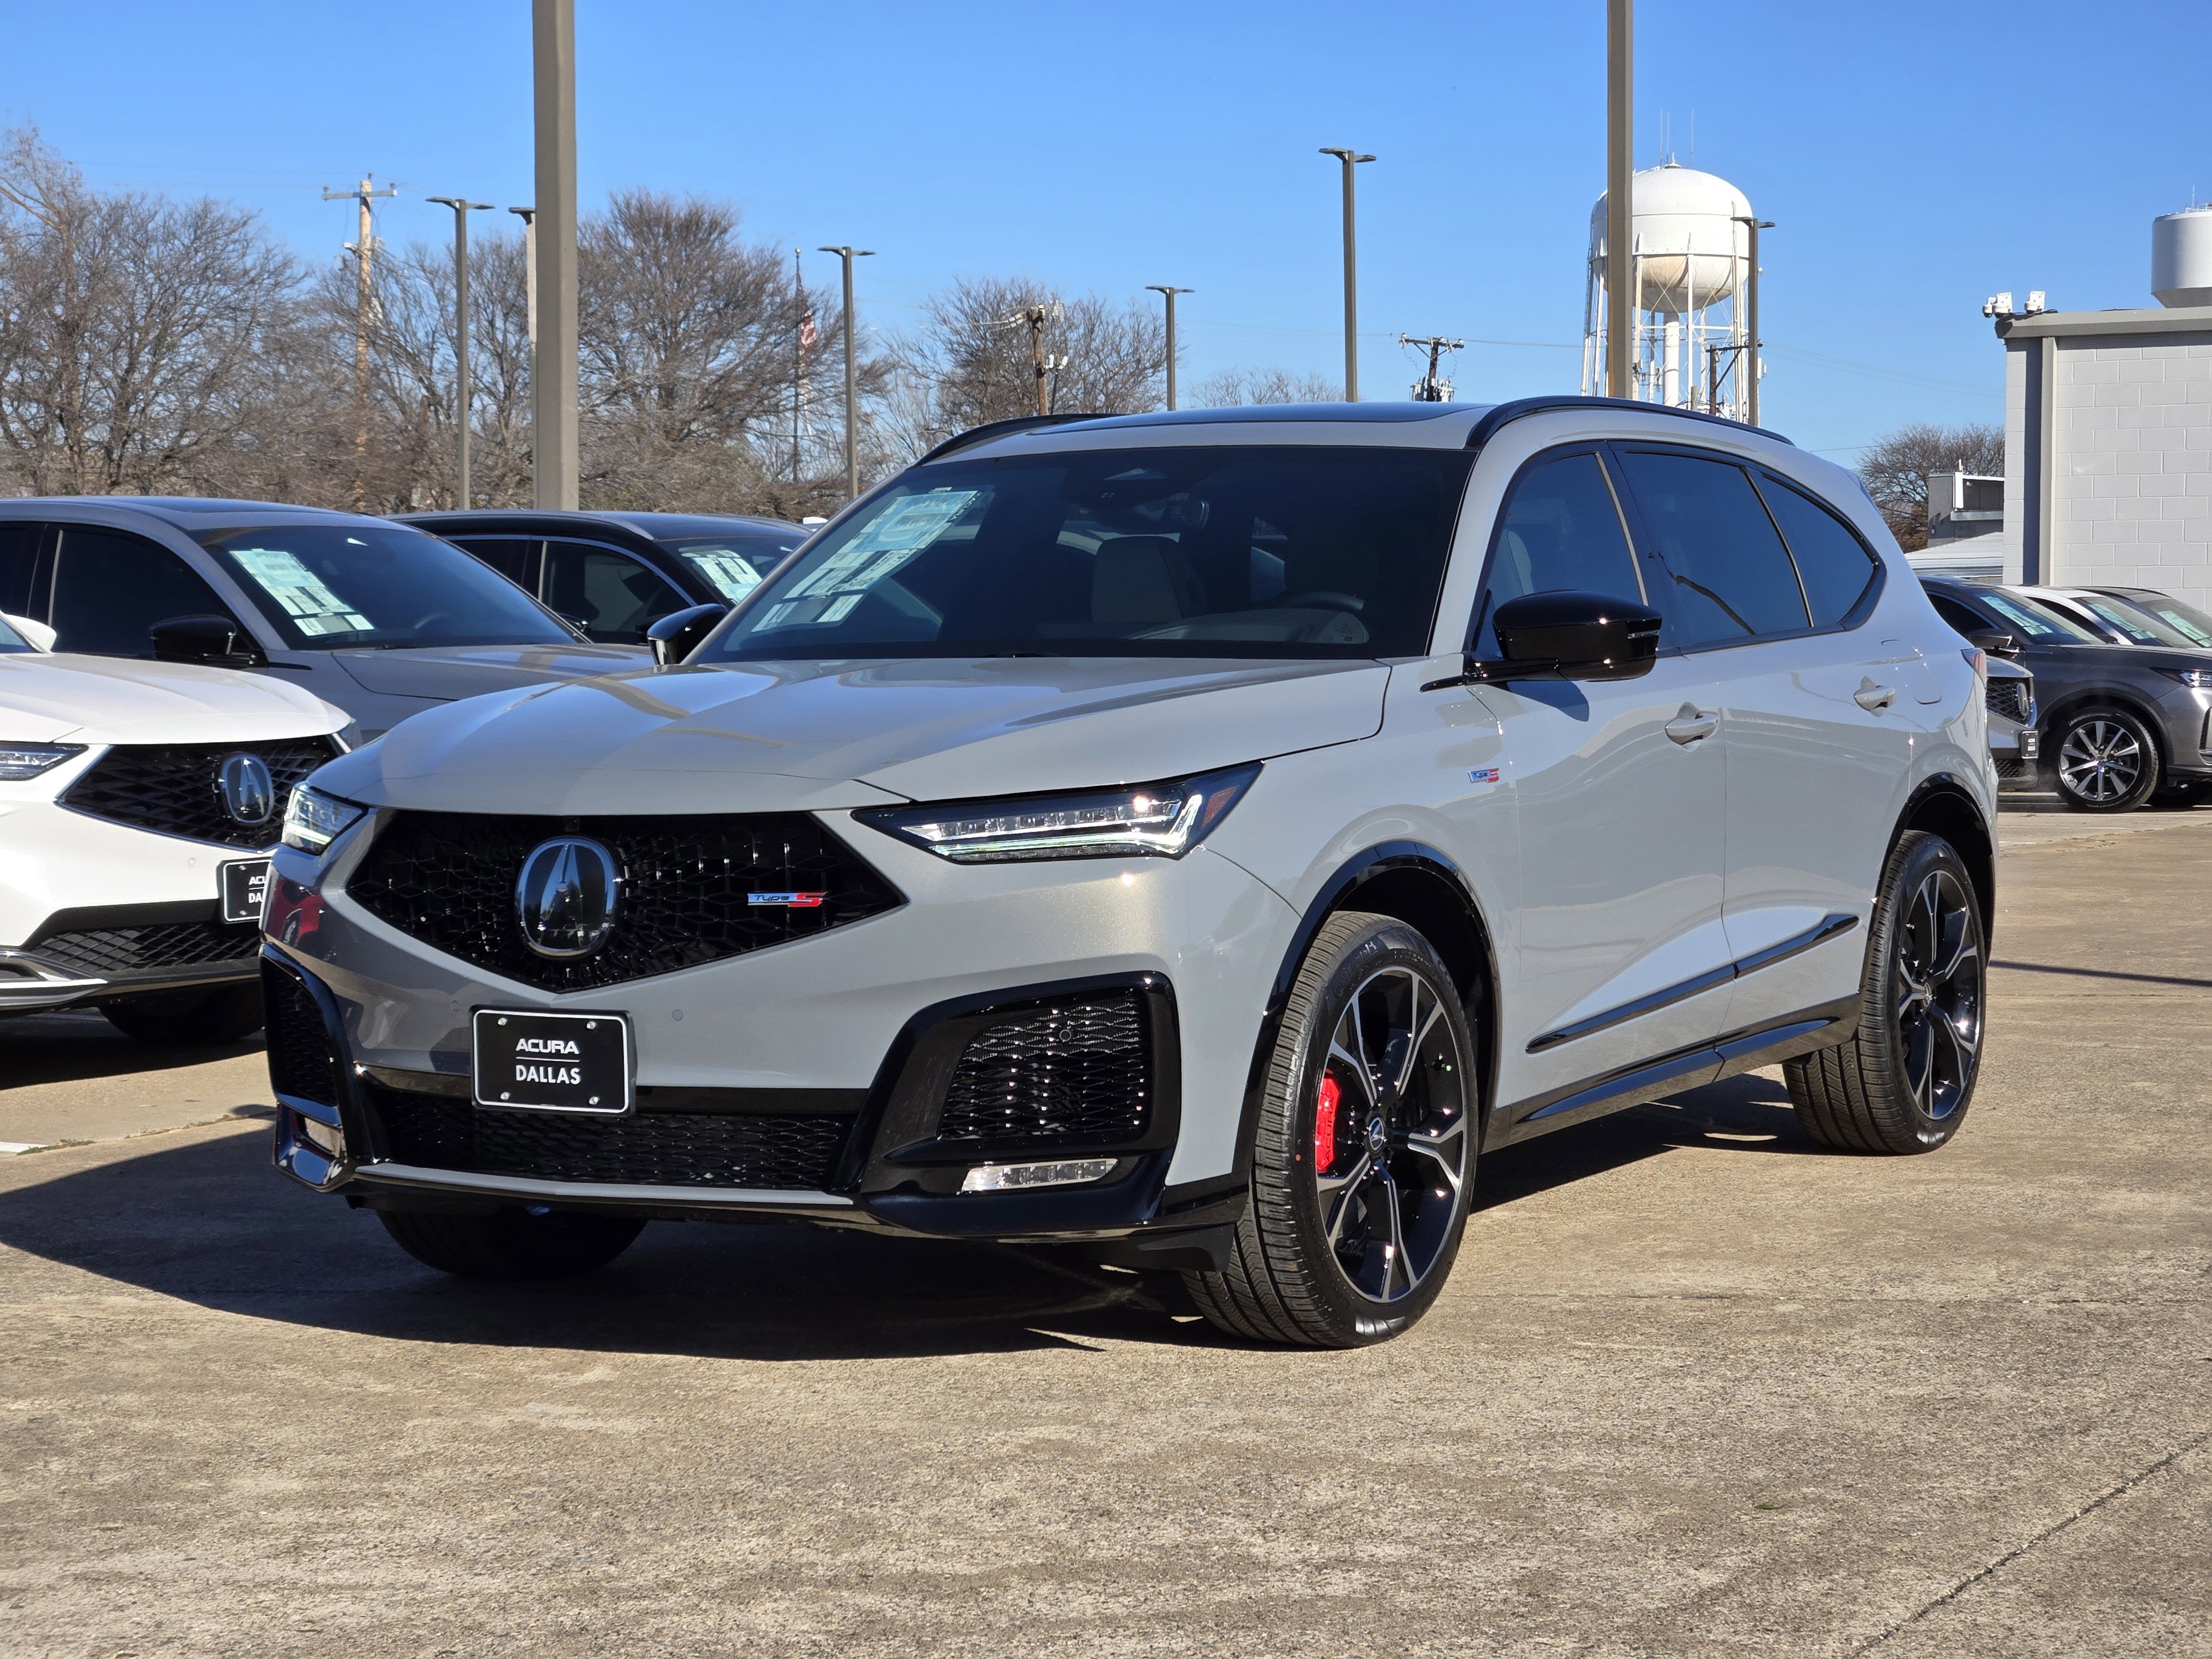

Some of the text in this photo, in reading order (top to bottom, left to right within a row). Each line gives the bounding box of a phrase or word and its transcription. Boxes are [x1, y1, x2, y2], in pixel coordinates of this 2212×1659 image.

[787, 892, 827, 907] S
[515, 1038, 580, 1054] ACURA
[515, 1065, 581, 1084] DALLAS
[1325, 1096, 1334, 1162] ACURA
